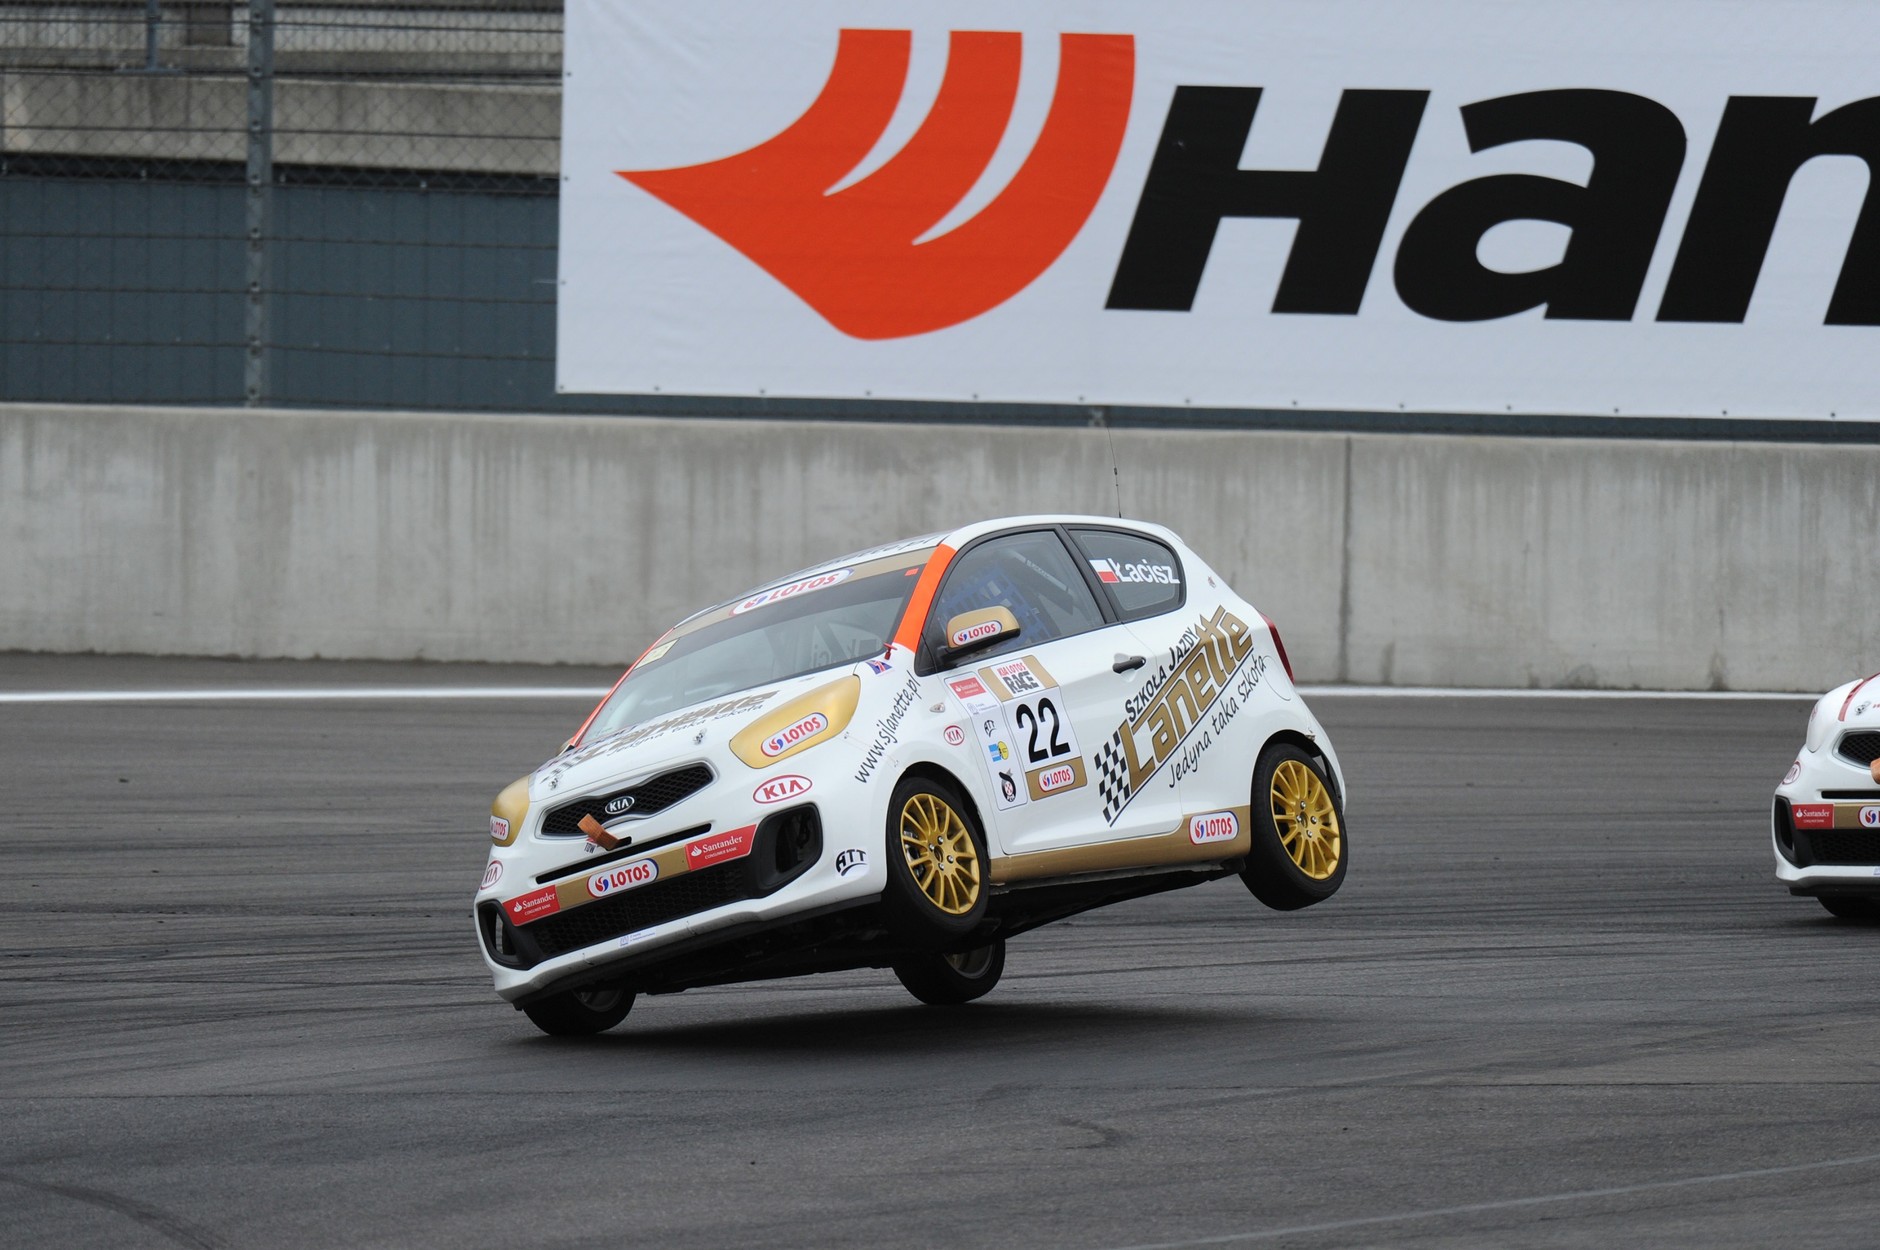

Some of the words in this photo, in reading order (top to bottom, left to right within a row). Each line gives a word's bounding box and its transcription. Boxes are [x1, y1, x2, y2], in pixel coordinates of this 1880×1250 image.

[1107, 558, 1180, 583] Łacisz
[768, 573, 840, 600] LOTOS
[968, 623, 996, 639] LOTOS
[996, 667, 1009, 677] KIA
[1007, 662, 1027, 675] LOTOS
[1002, 671, 1039, 695] RACE
[1118, 604, 1254, 795] Lanette
[782, 716, 821, 744] LOTOS
[946, 729, 963, 742] KIA
[1016, 697, 1071, 763] 22
[1169, 731, 1212, 788] Jedyna
[1212, 696, 1240, 736] taka
[1050, 768, 1071, 785] LOTOS
[762, 779, 805, 801] KIA
[609, 799, 630, 812] KIA
[1803, 809, 1830, 817] Santander
[1205, 817, 1233, 837] LOTOS
[703, 835, 743, 853] Santander
[610, 863, 651, 888] LOTOS
[522, 892, 556, 910] Santander
